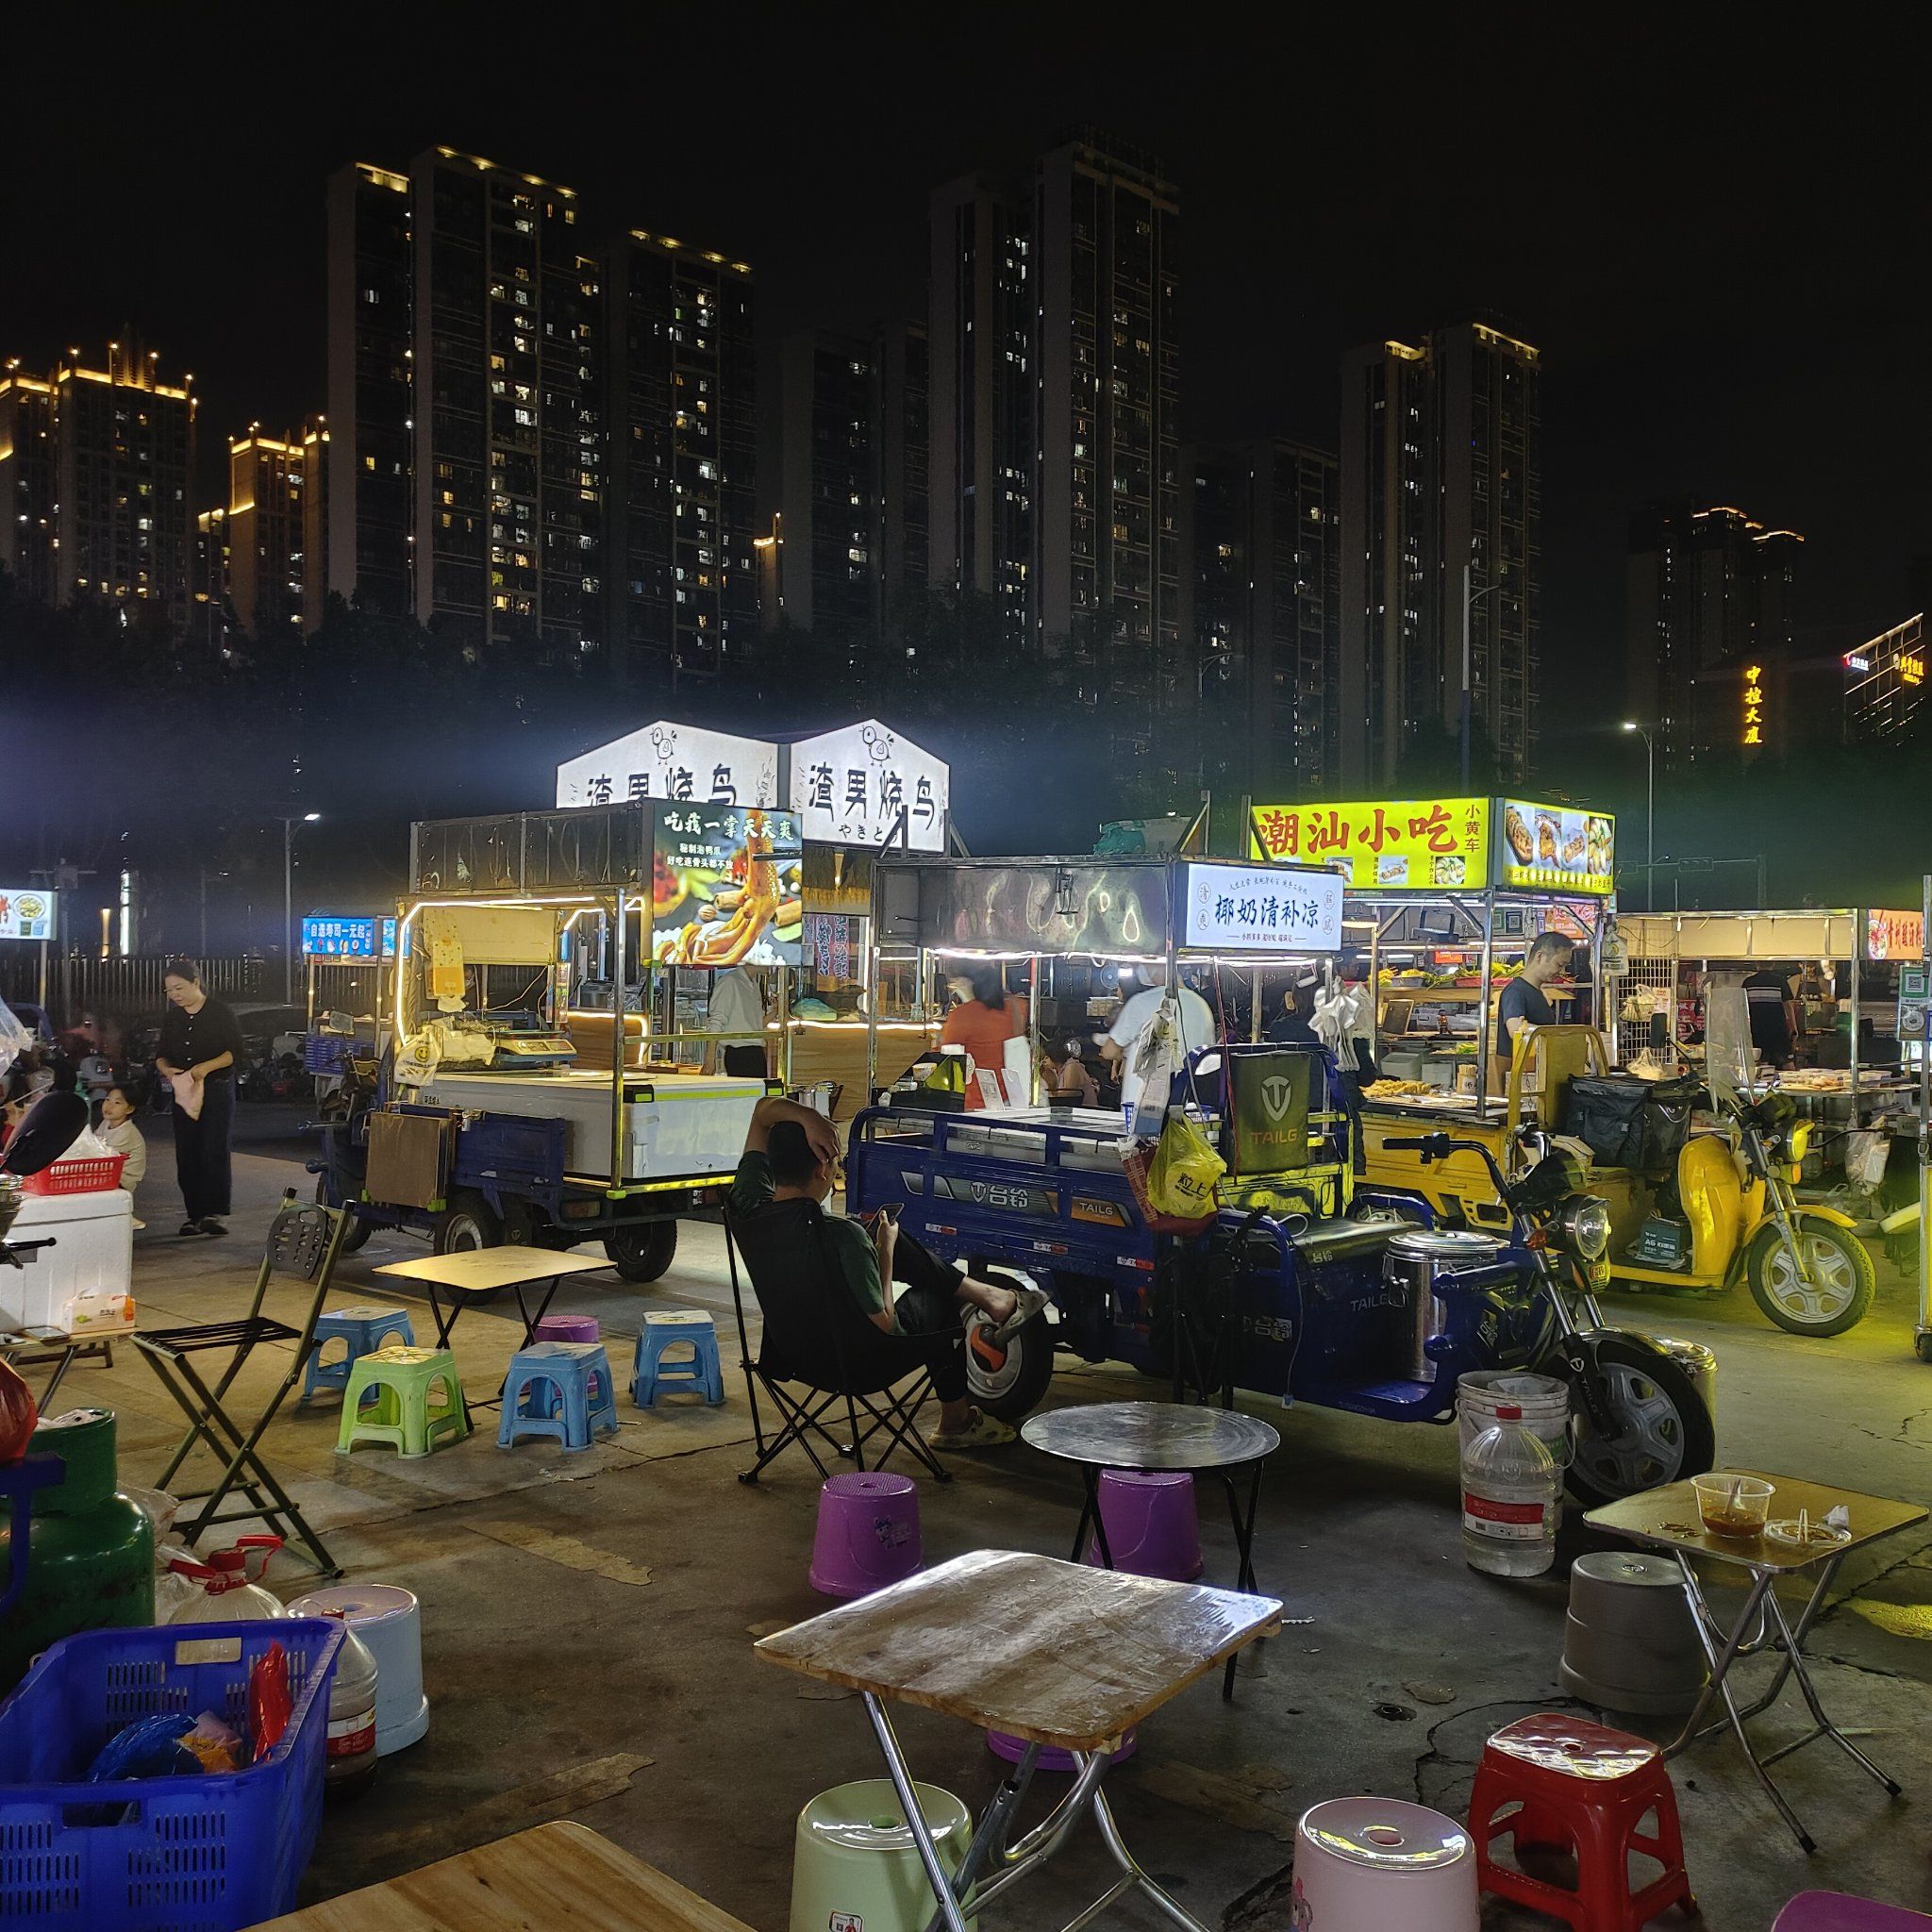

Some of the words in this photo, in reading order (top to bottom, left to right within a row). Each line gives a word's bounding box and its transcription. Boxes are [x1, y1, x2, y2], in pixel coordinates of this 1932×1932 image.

[808, 761, 935, 831] 渣男烧鸟
[663, 810, 794, 841] 吃我一掌天天爽
[839, 823, 898, 843] やきと
[1259, 804, 1458, 856] 潮汕小吃
[1464, 804, 1481, 853] 小黄车
[1214, 893, 1320, 929] 椰奶清补凉
[1251, 1128, 1298, 1145] TAILG
[990, 1186, 1029, 1208] 台铃
[1079, 1201, 1113, 1216] TAILG
